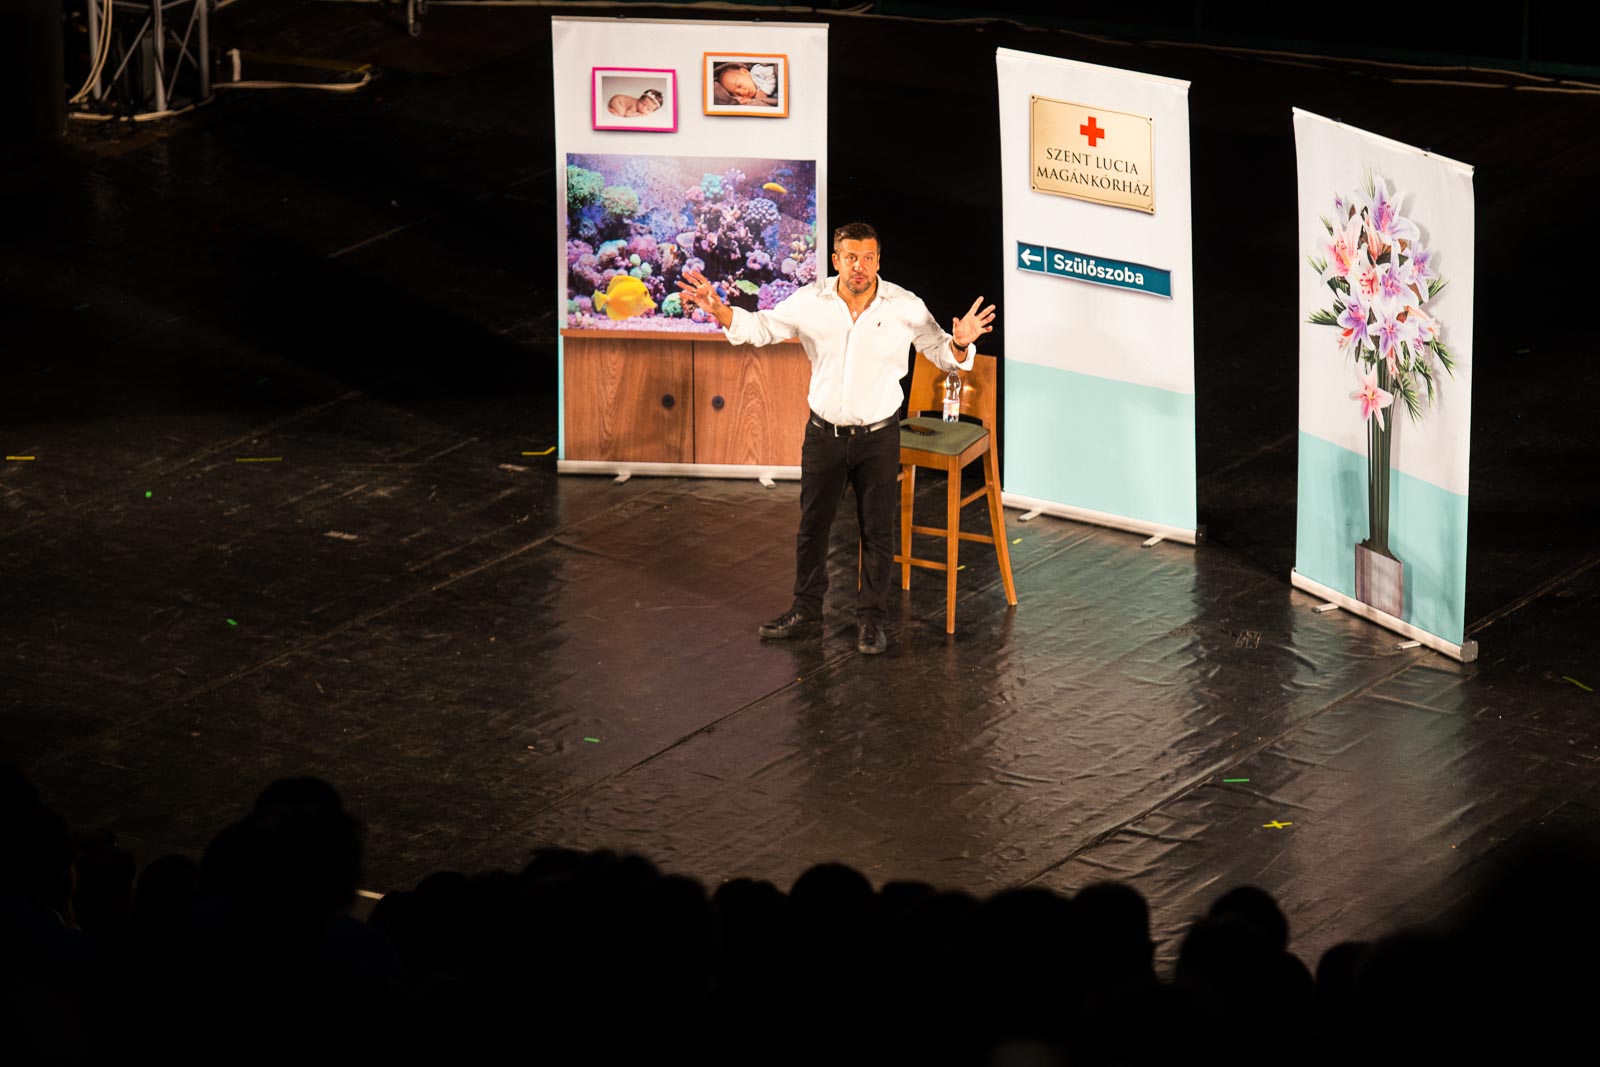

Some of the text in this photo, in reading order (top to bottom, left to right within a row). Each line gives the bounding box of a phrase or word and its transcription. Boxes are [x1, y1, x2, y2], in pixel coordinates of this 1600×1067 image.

[1046, 147, 1139, 175] SZENT LUCIA
[1036, 166, 1150, 197] MAGÁNKÓRHÁZ
[1053, 254, 1144, 285] Szülőszoba
